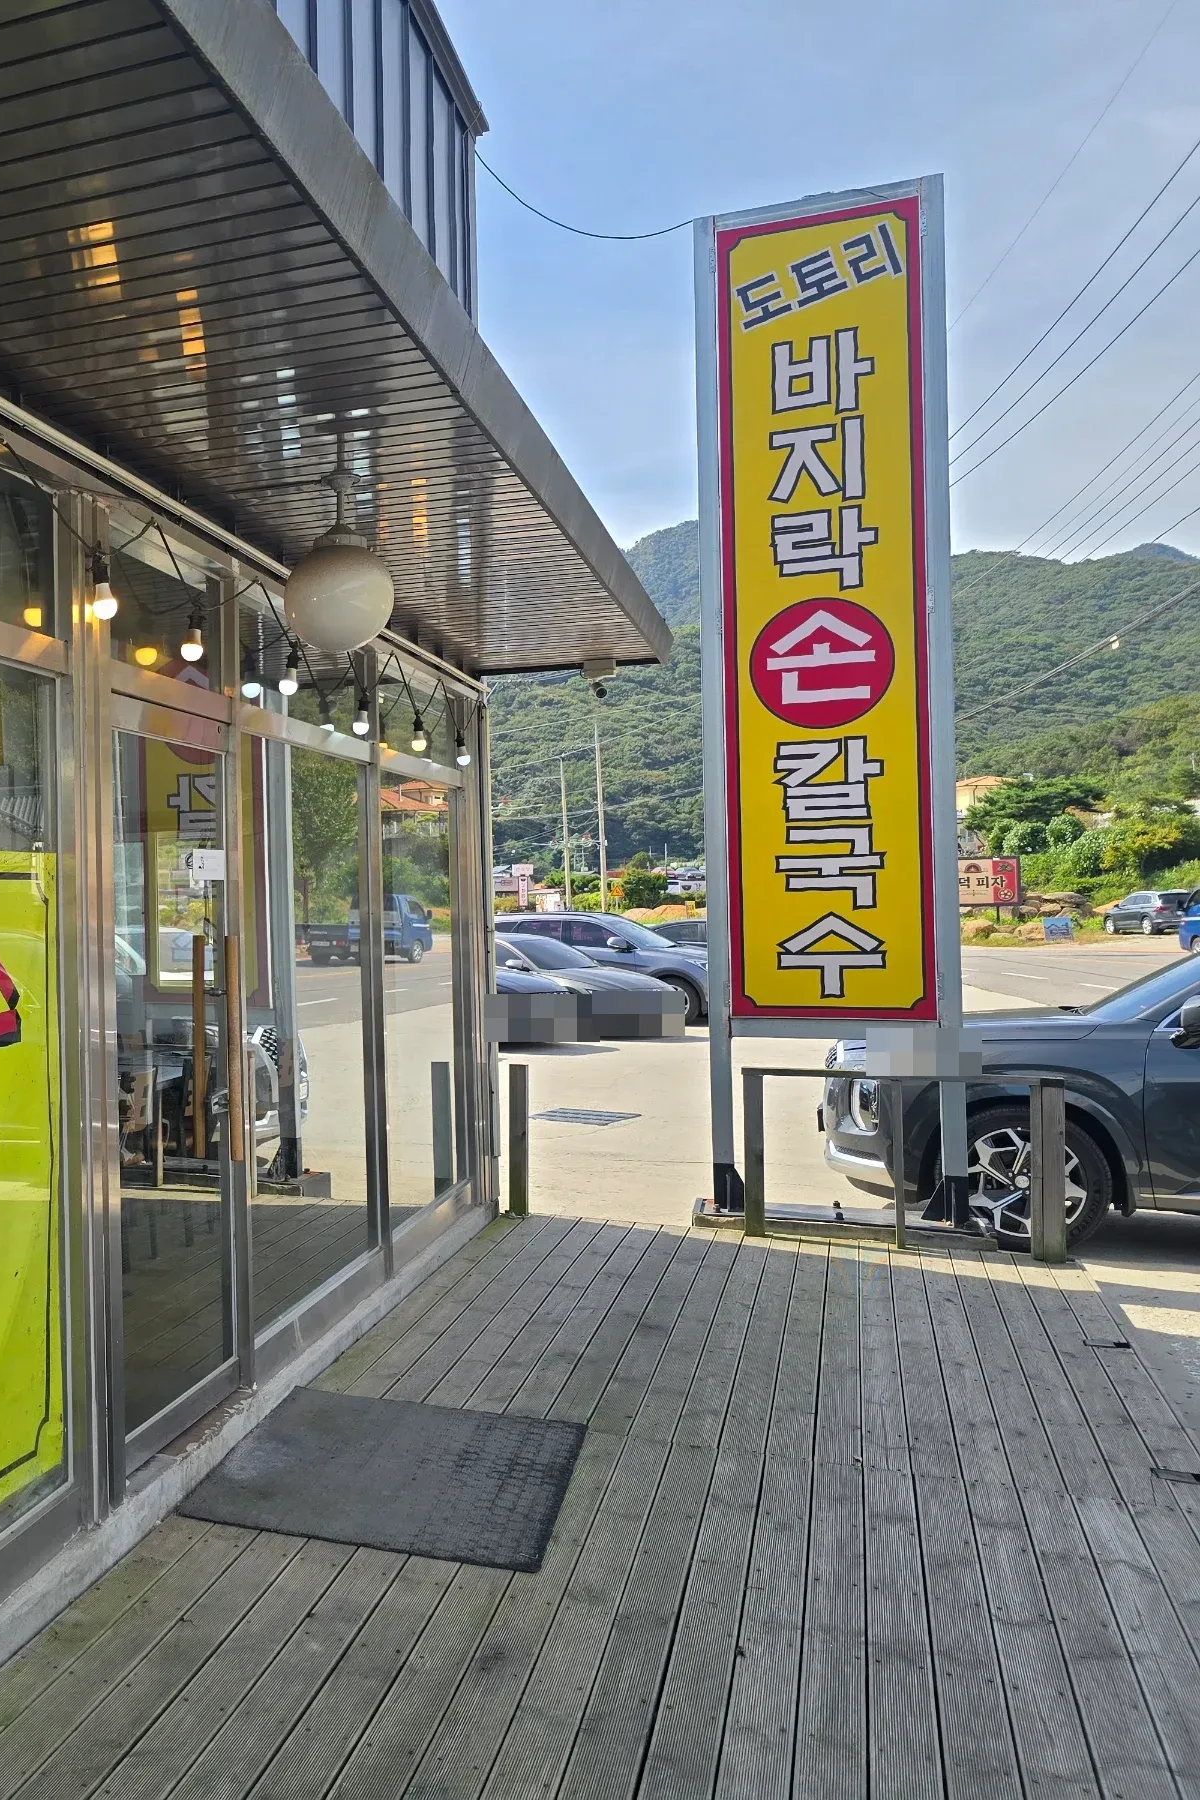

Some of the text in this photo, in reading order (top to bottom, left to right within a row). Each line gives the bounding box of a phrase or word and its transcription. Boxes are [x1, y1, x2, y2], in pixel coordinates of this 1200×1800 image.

[733, 220, 904, 332] 도토리
[767, 326, 879, 591] 바지락
[975, 875, 1006, 889] 피자
